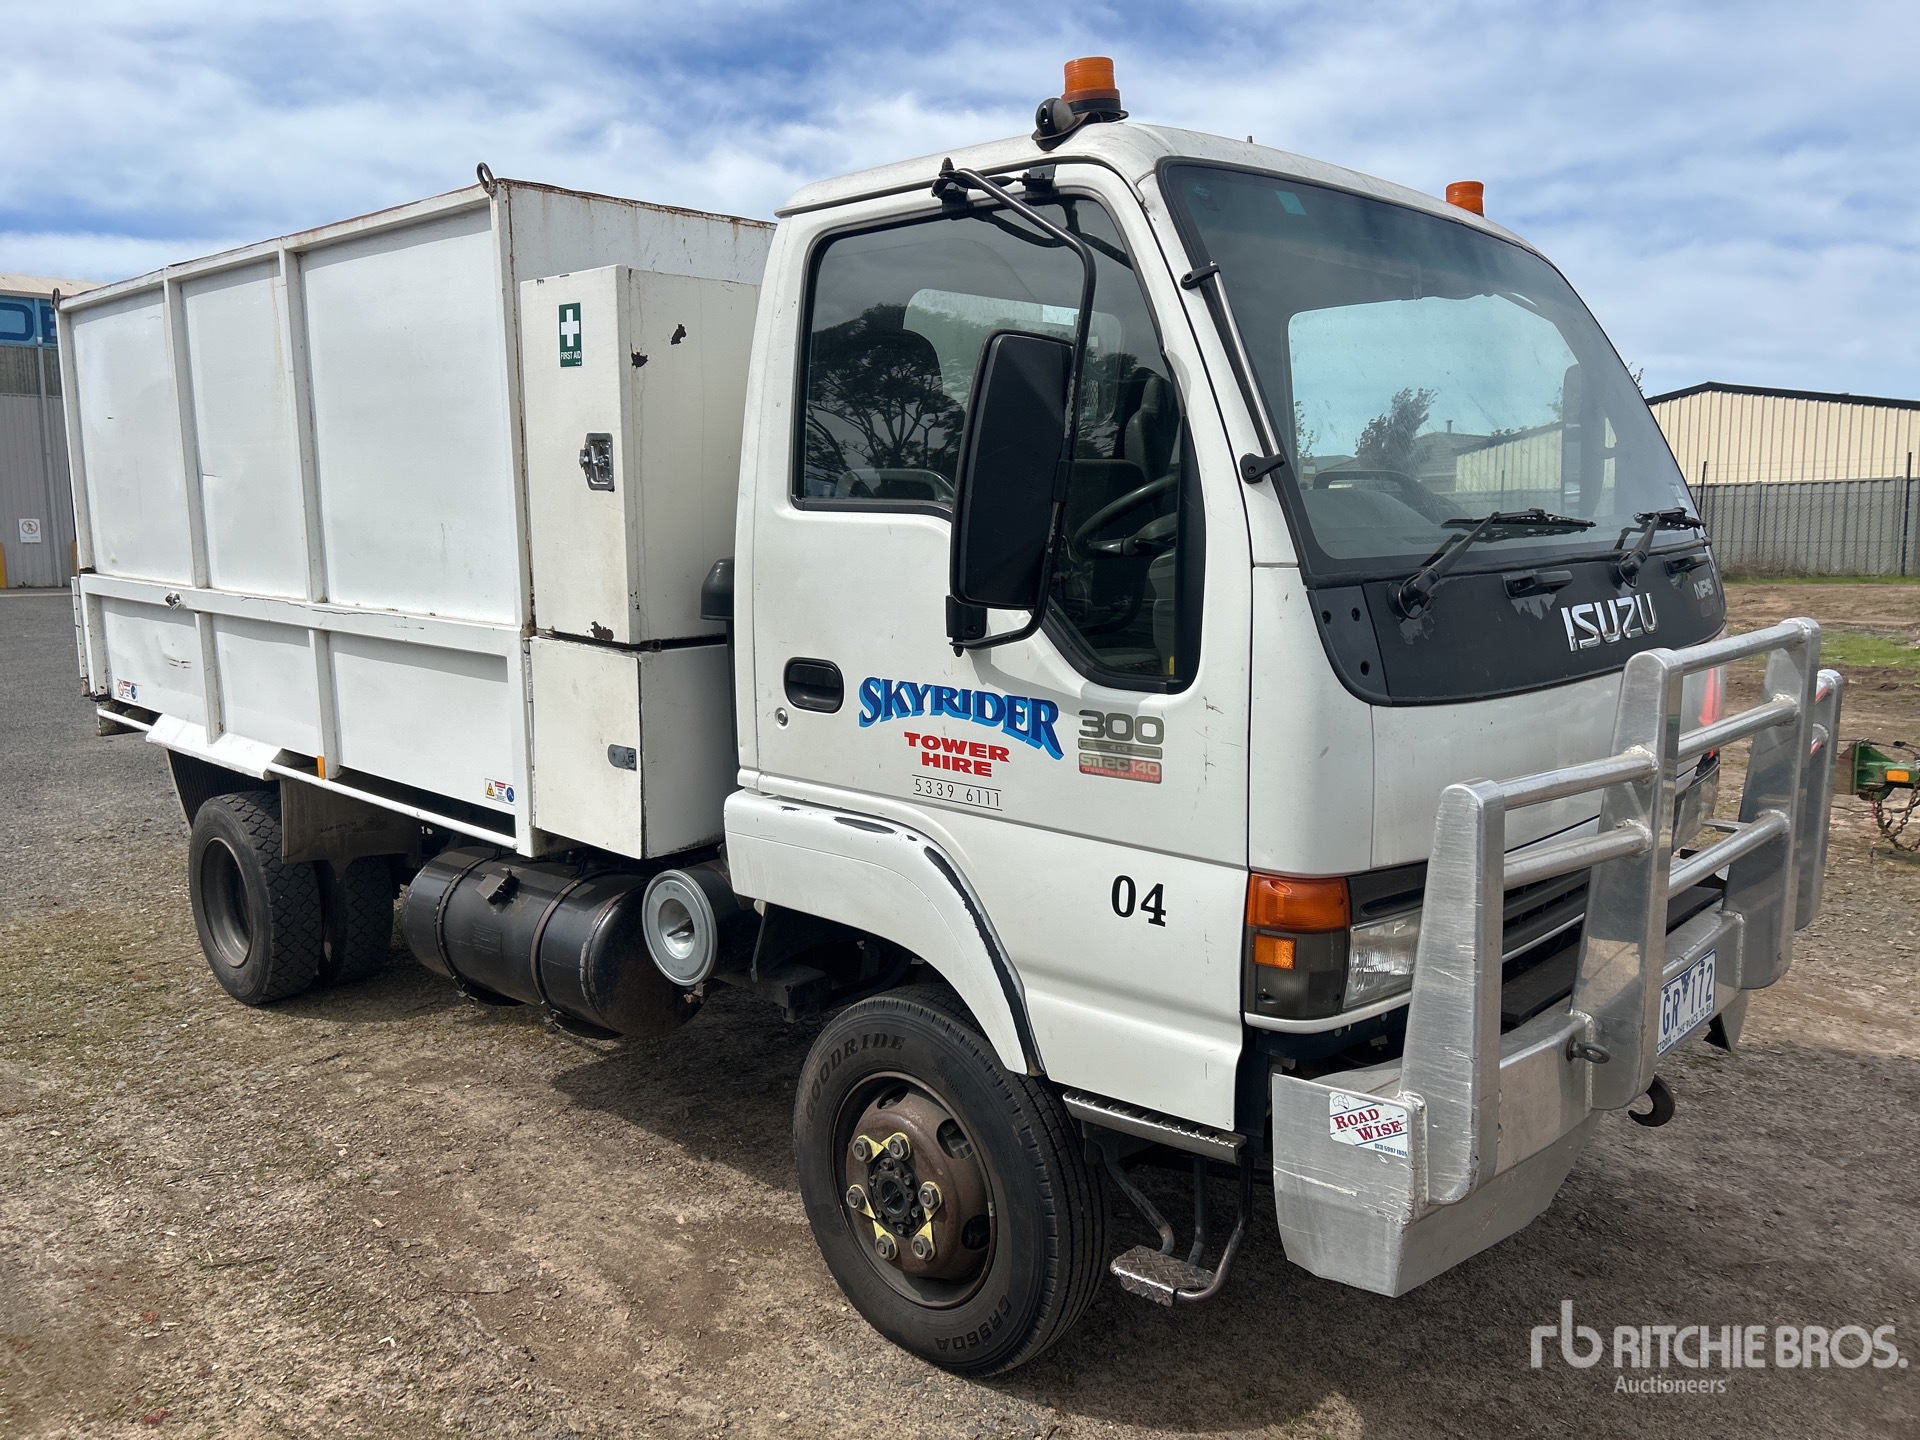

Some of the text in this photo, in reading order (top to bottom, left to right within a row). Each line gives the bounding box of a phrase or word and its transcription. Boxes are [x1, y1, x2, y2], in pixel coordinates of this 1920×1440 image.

[560, 350, 582, 360] FIRST AID
[1561, 592, 1659, 651] ISUZU
[858, 676, 1065, 761] SKYRIDER
[1078, 709, 1165, 745] 300
[904, 731, 1011, 763] TOWER
[921, 751, 993, 778] HIRE
[1129, 760, 1160, 776] 140
[915, 778, 999, 807] 5339 6111
[1111, 874, 1167, 928] 04
[1662, 962, 1713, 1036] GR 172
[1686, 1012, 1698, 1030] PLACE
[805, 1032, 906, 1123] GOODRIDE
[1333, 1108, 1380, 1130] ROAD
[1355, 1120, 1403, 1141] WISE
